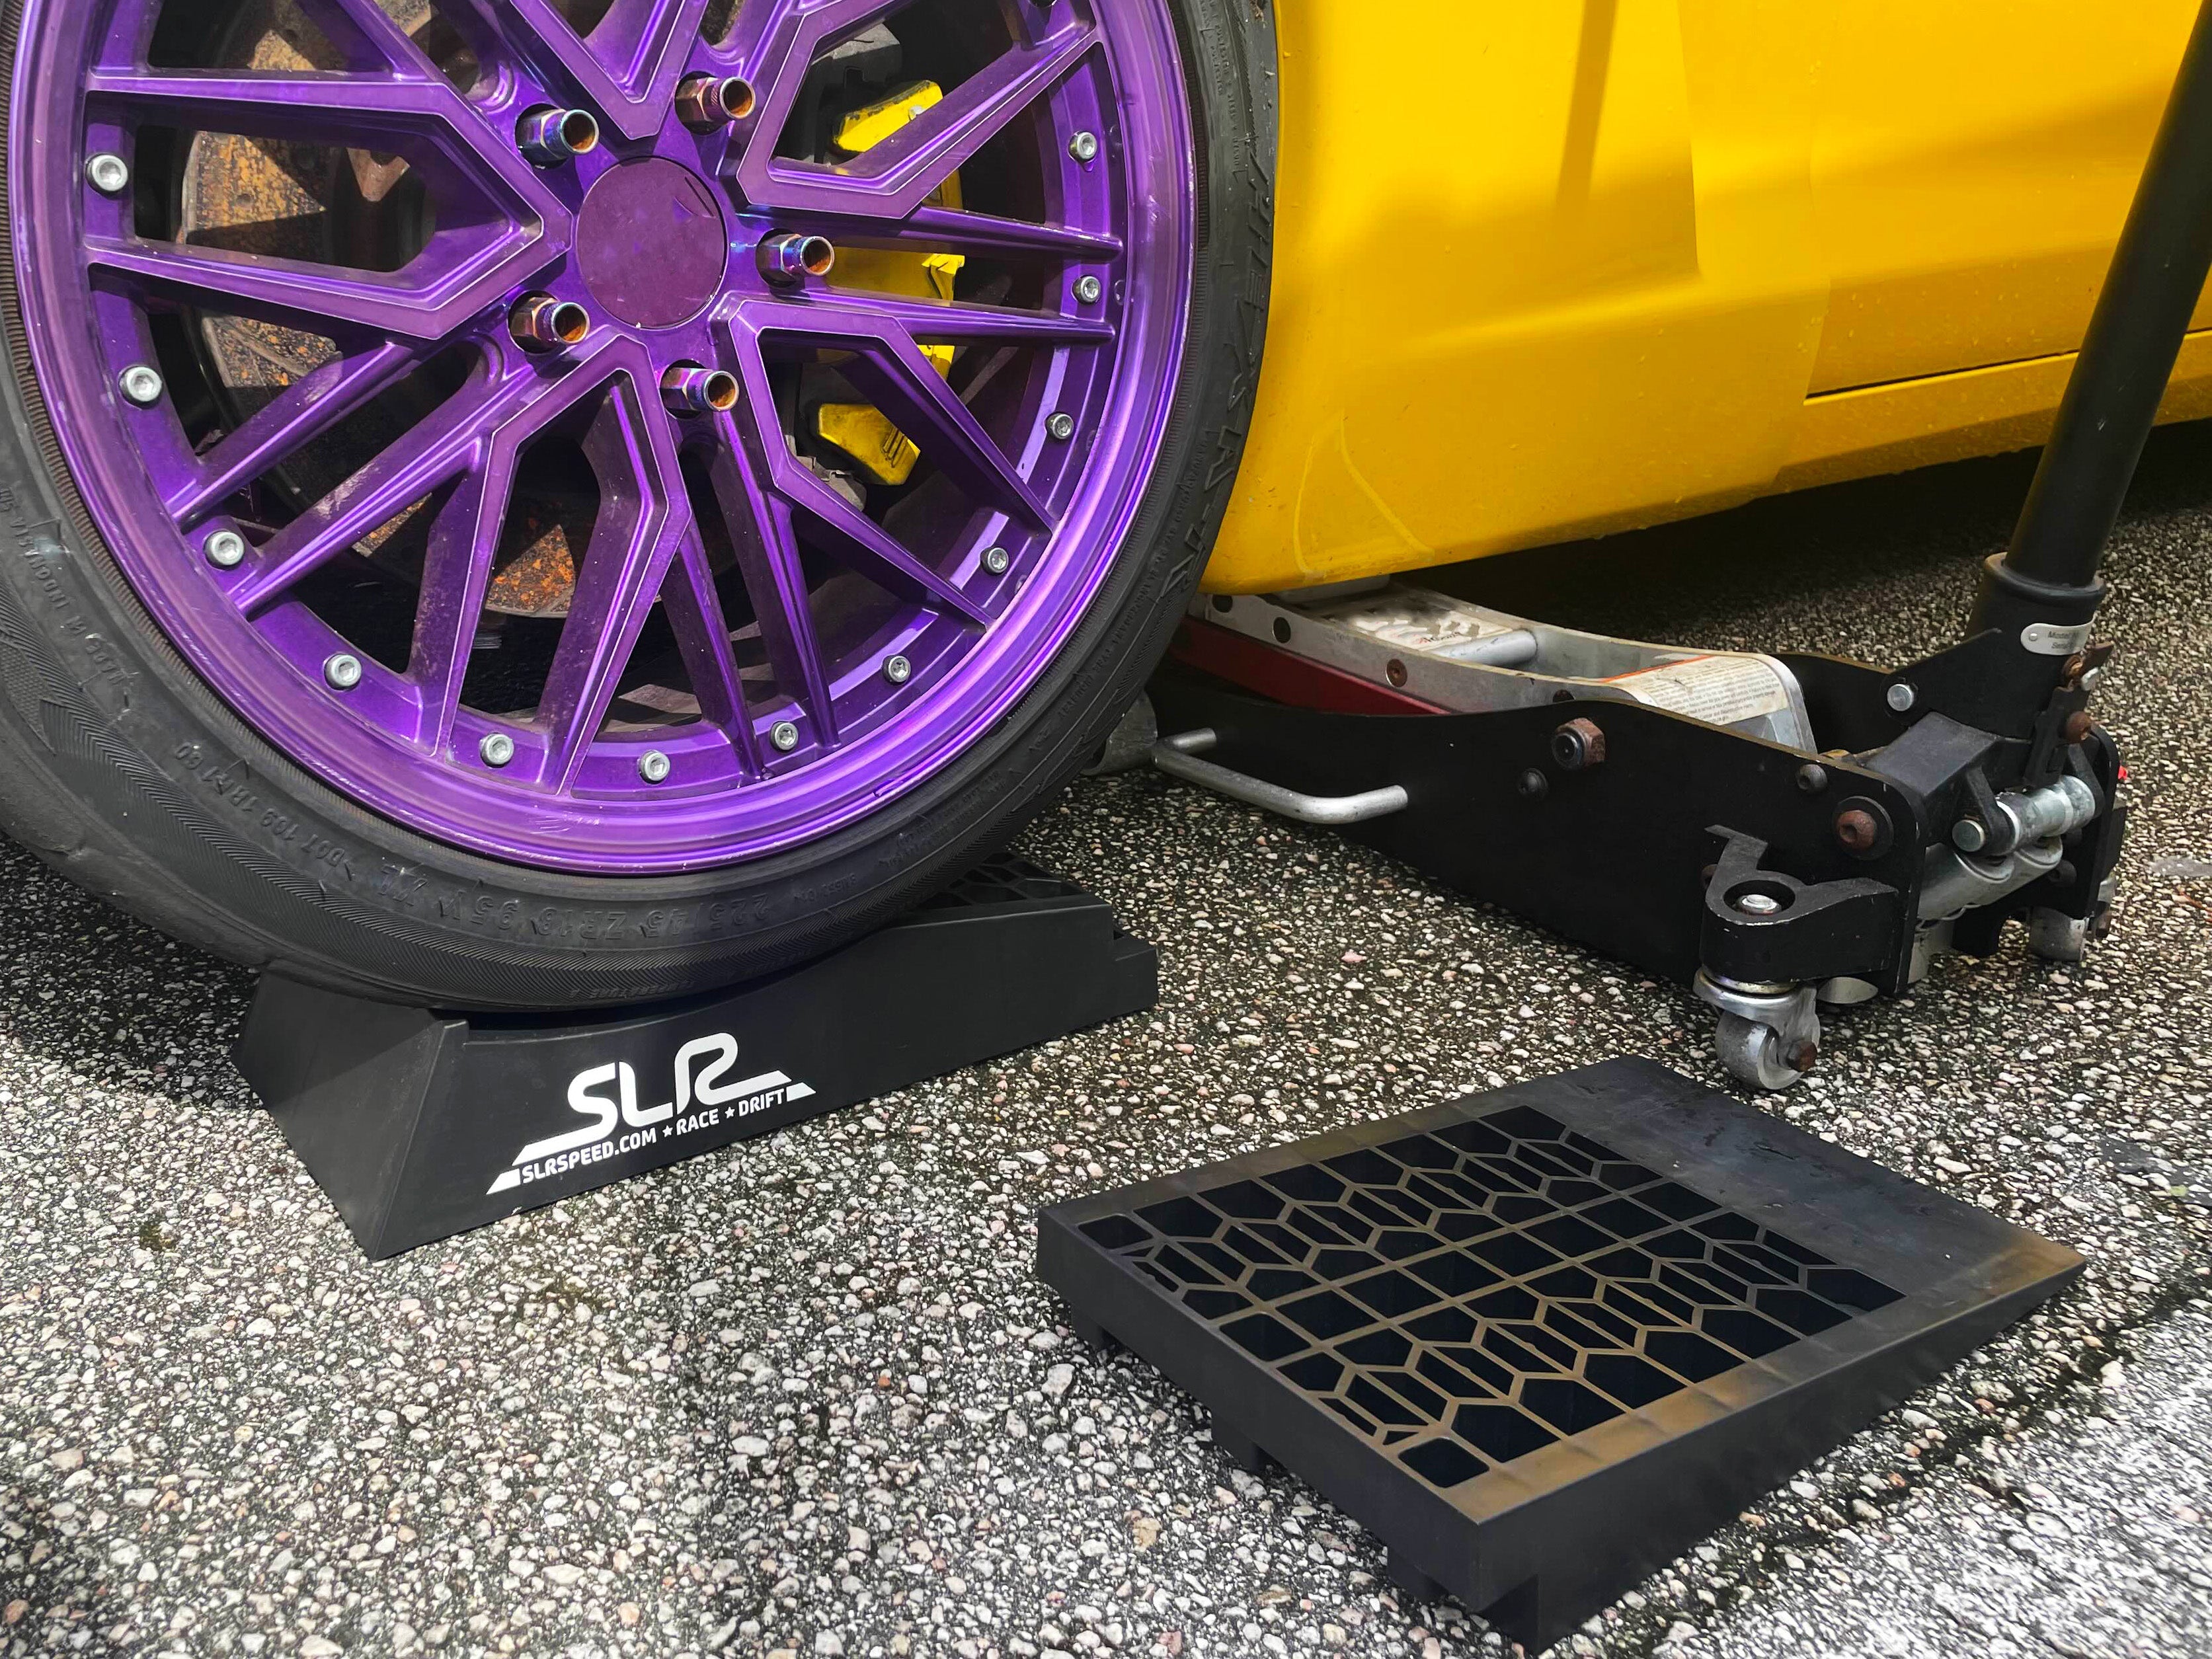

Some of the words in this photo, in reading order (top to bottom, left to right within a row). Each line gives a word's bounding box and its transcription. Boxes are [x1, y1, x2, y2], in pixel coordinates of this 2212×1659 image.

[299, 830, 346, 870] DOT
[512, 1032, 791, 1166] SLR
[522, 1128, 656, 1184] SLRSPEED.COM
[676, 1108, 720, 1136] RACE
[738, 1087, 784, 1117] DRIFT
